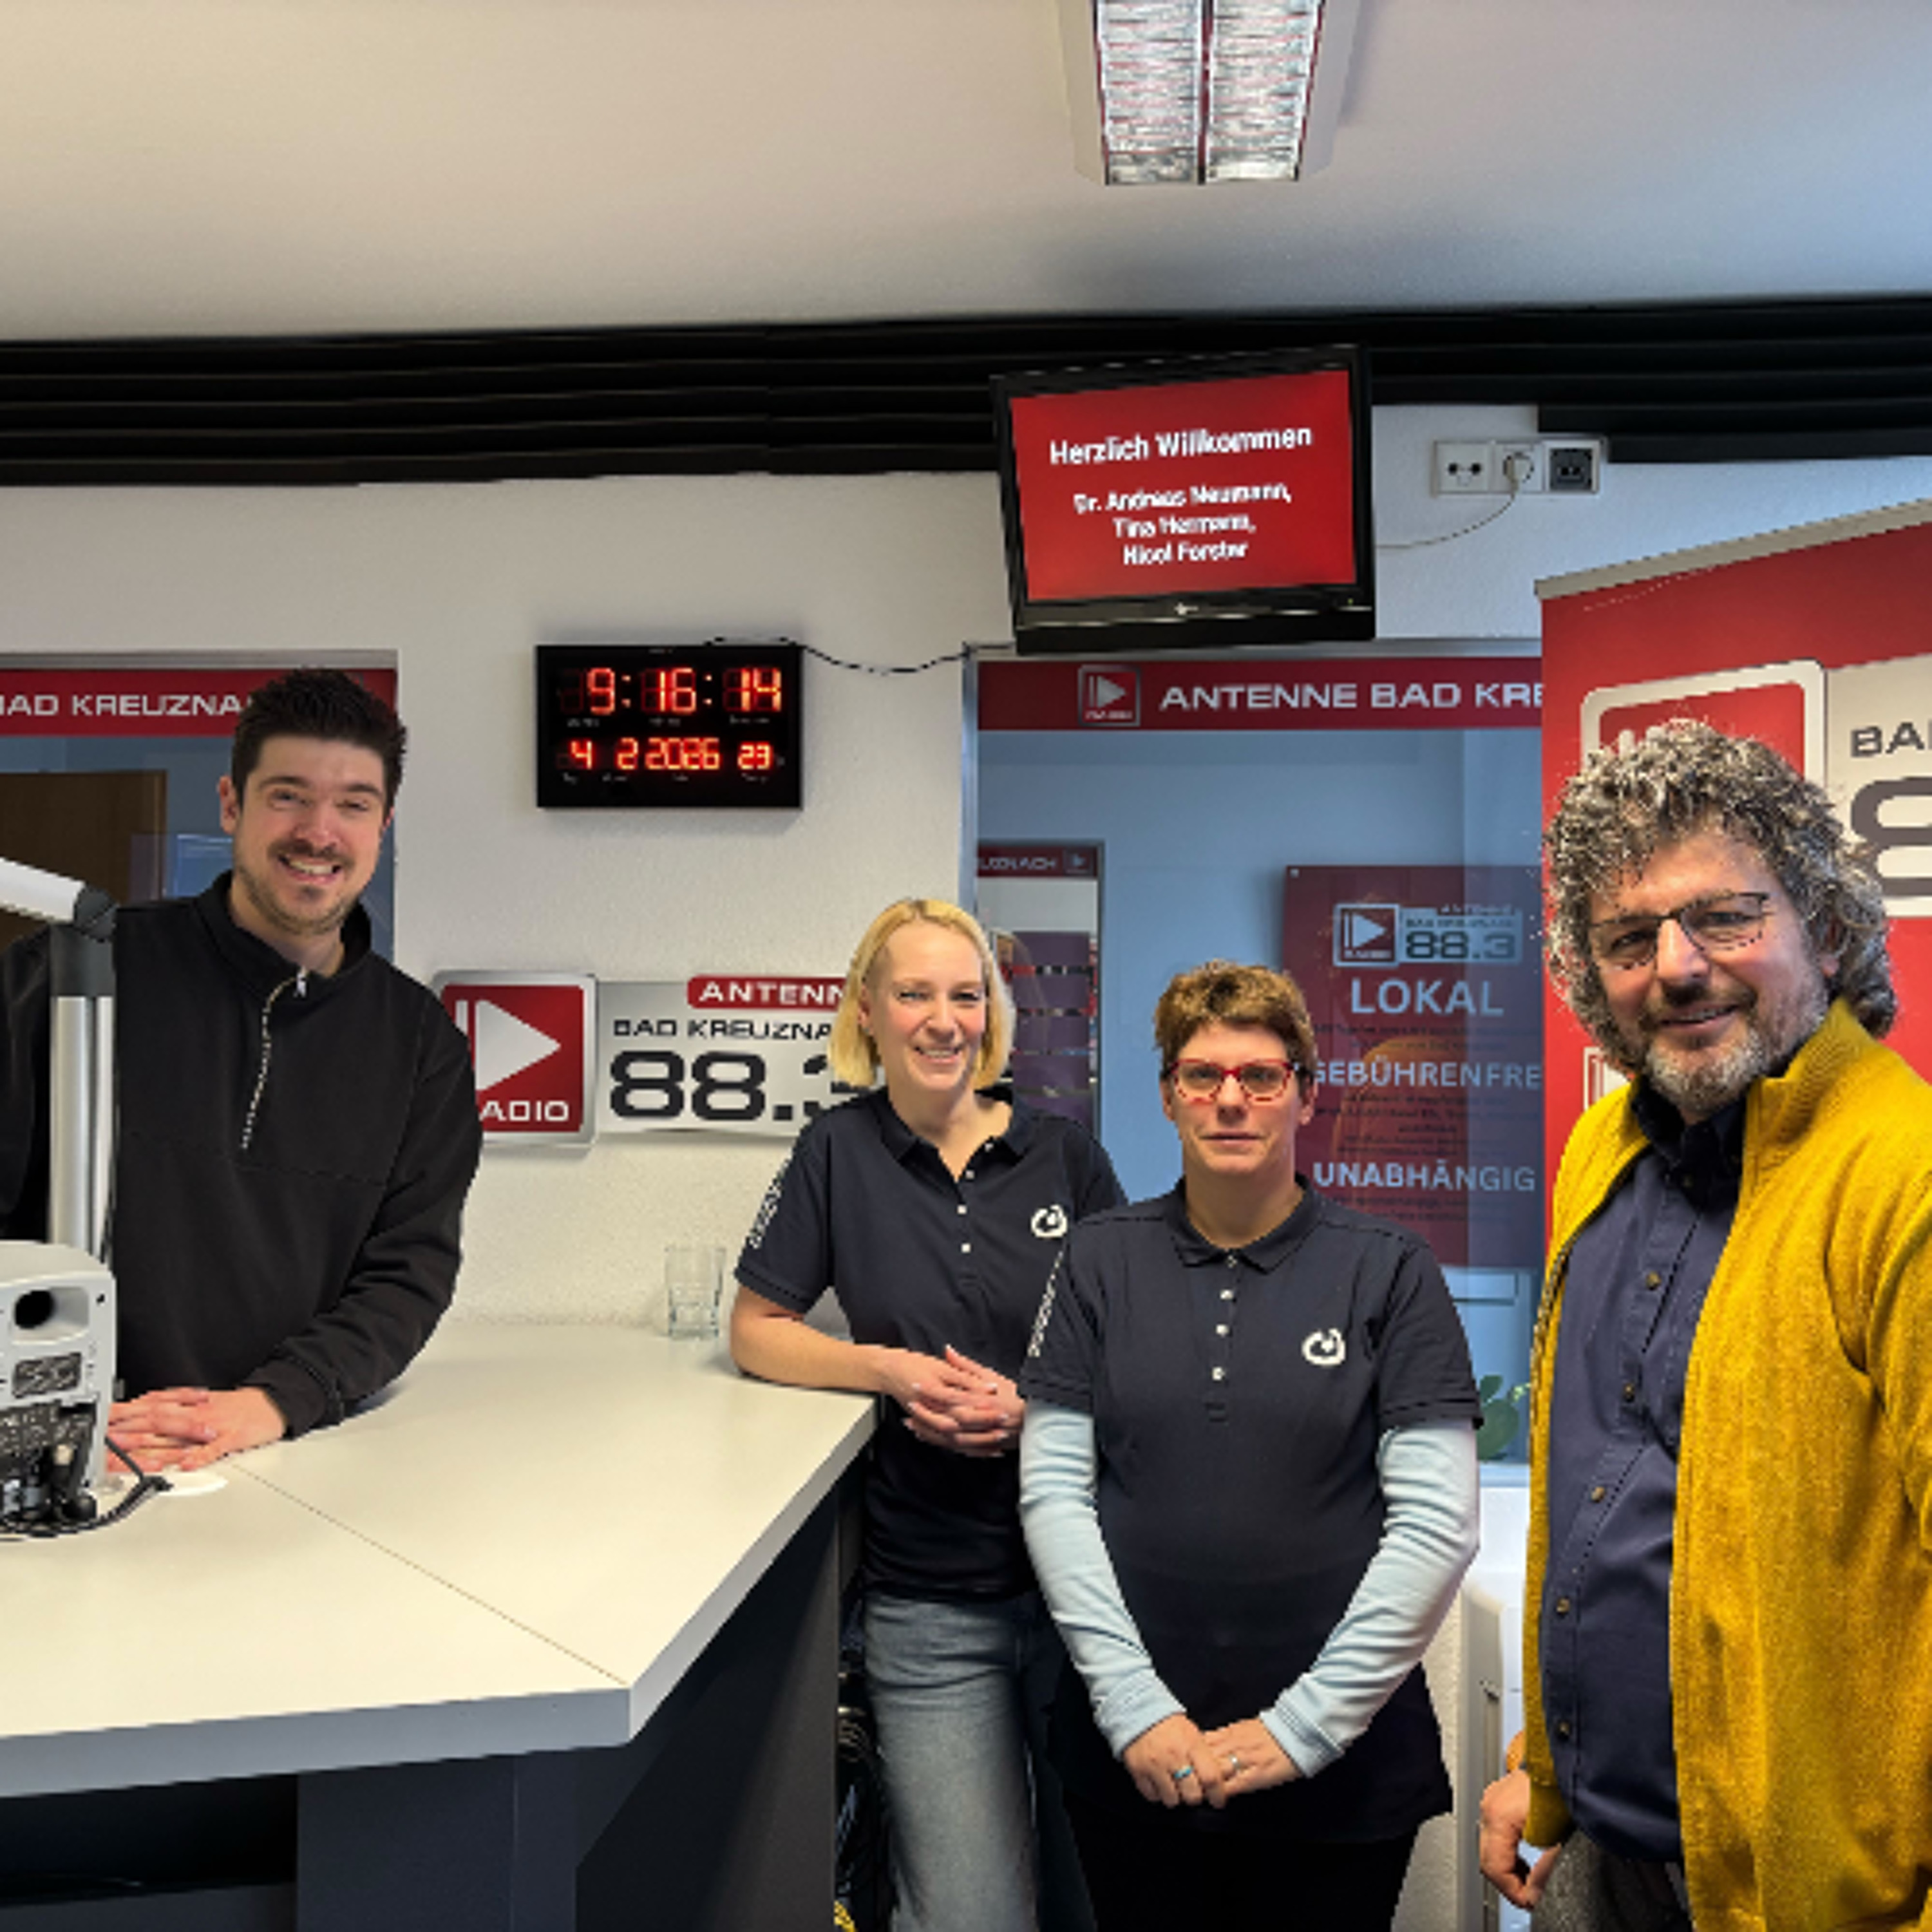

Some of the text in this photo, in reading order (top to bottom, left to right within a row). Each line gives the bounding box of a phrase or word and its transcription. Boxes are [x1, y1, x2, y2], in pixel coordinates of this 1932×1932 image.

[1050, 428, 1312, 465] Herzlich Willkommen
[0, 694, 252, 716] AD KREUZNA
[1159, 683, 1358, 712] ANTENNE
[1370, 683, 1462, 709] BAD
[570, 740, 592, 771] 4
[616, 737, 639, 771] 2
[737, 743, 772, 771] 23
[1850, 721, 1932, 758] BA
[1406, 931, 1515, 959] 88.3
[1352, 978, 1504, 1016] LOKAL
[614, 1019, 677, 1037] BAD
[478, 1099, 569, 1122] ADIO
[1312, 1159, 1536, 1191] UNABHÄNGIG
